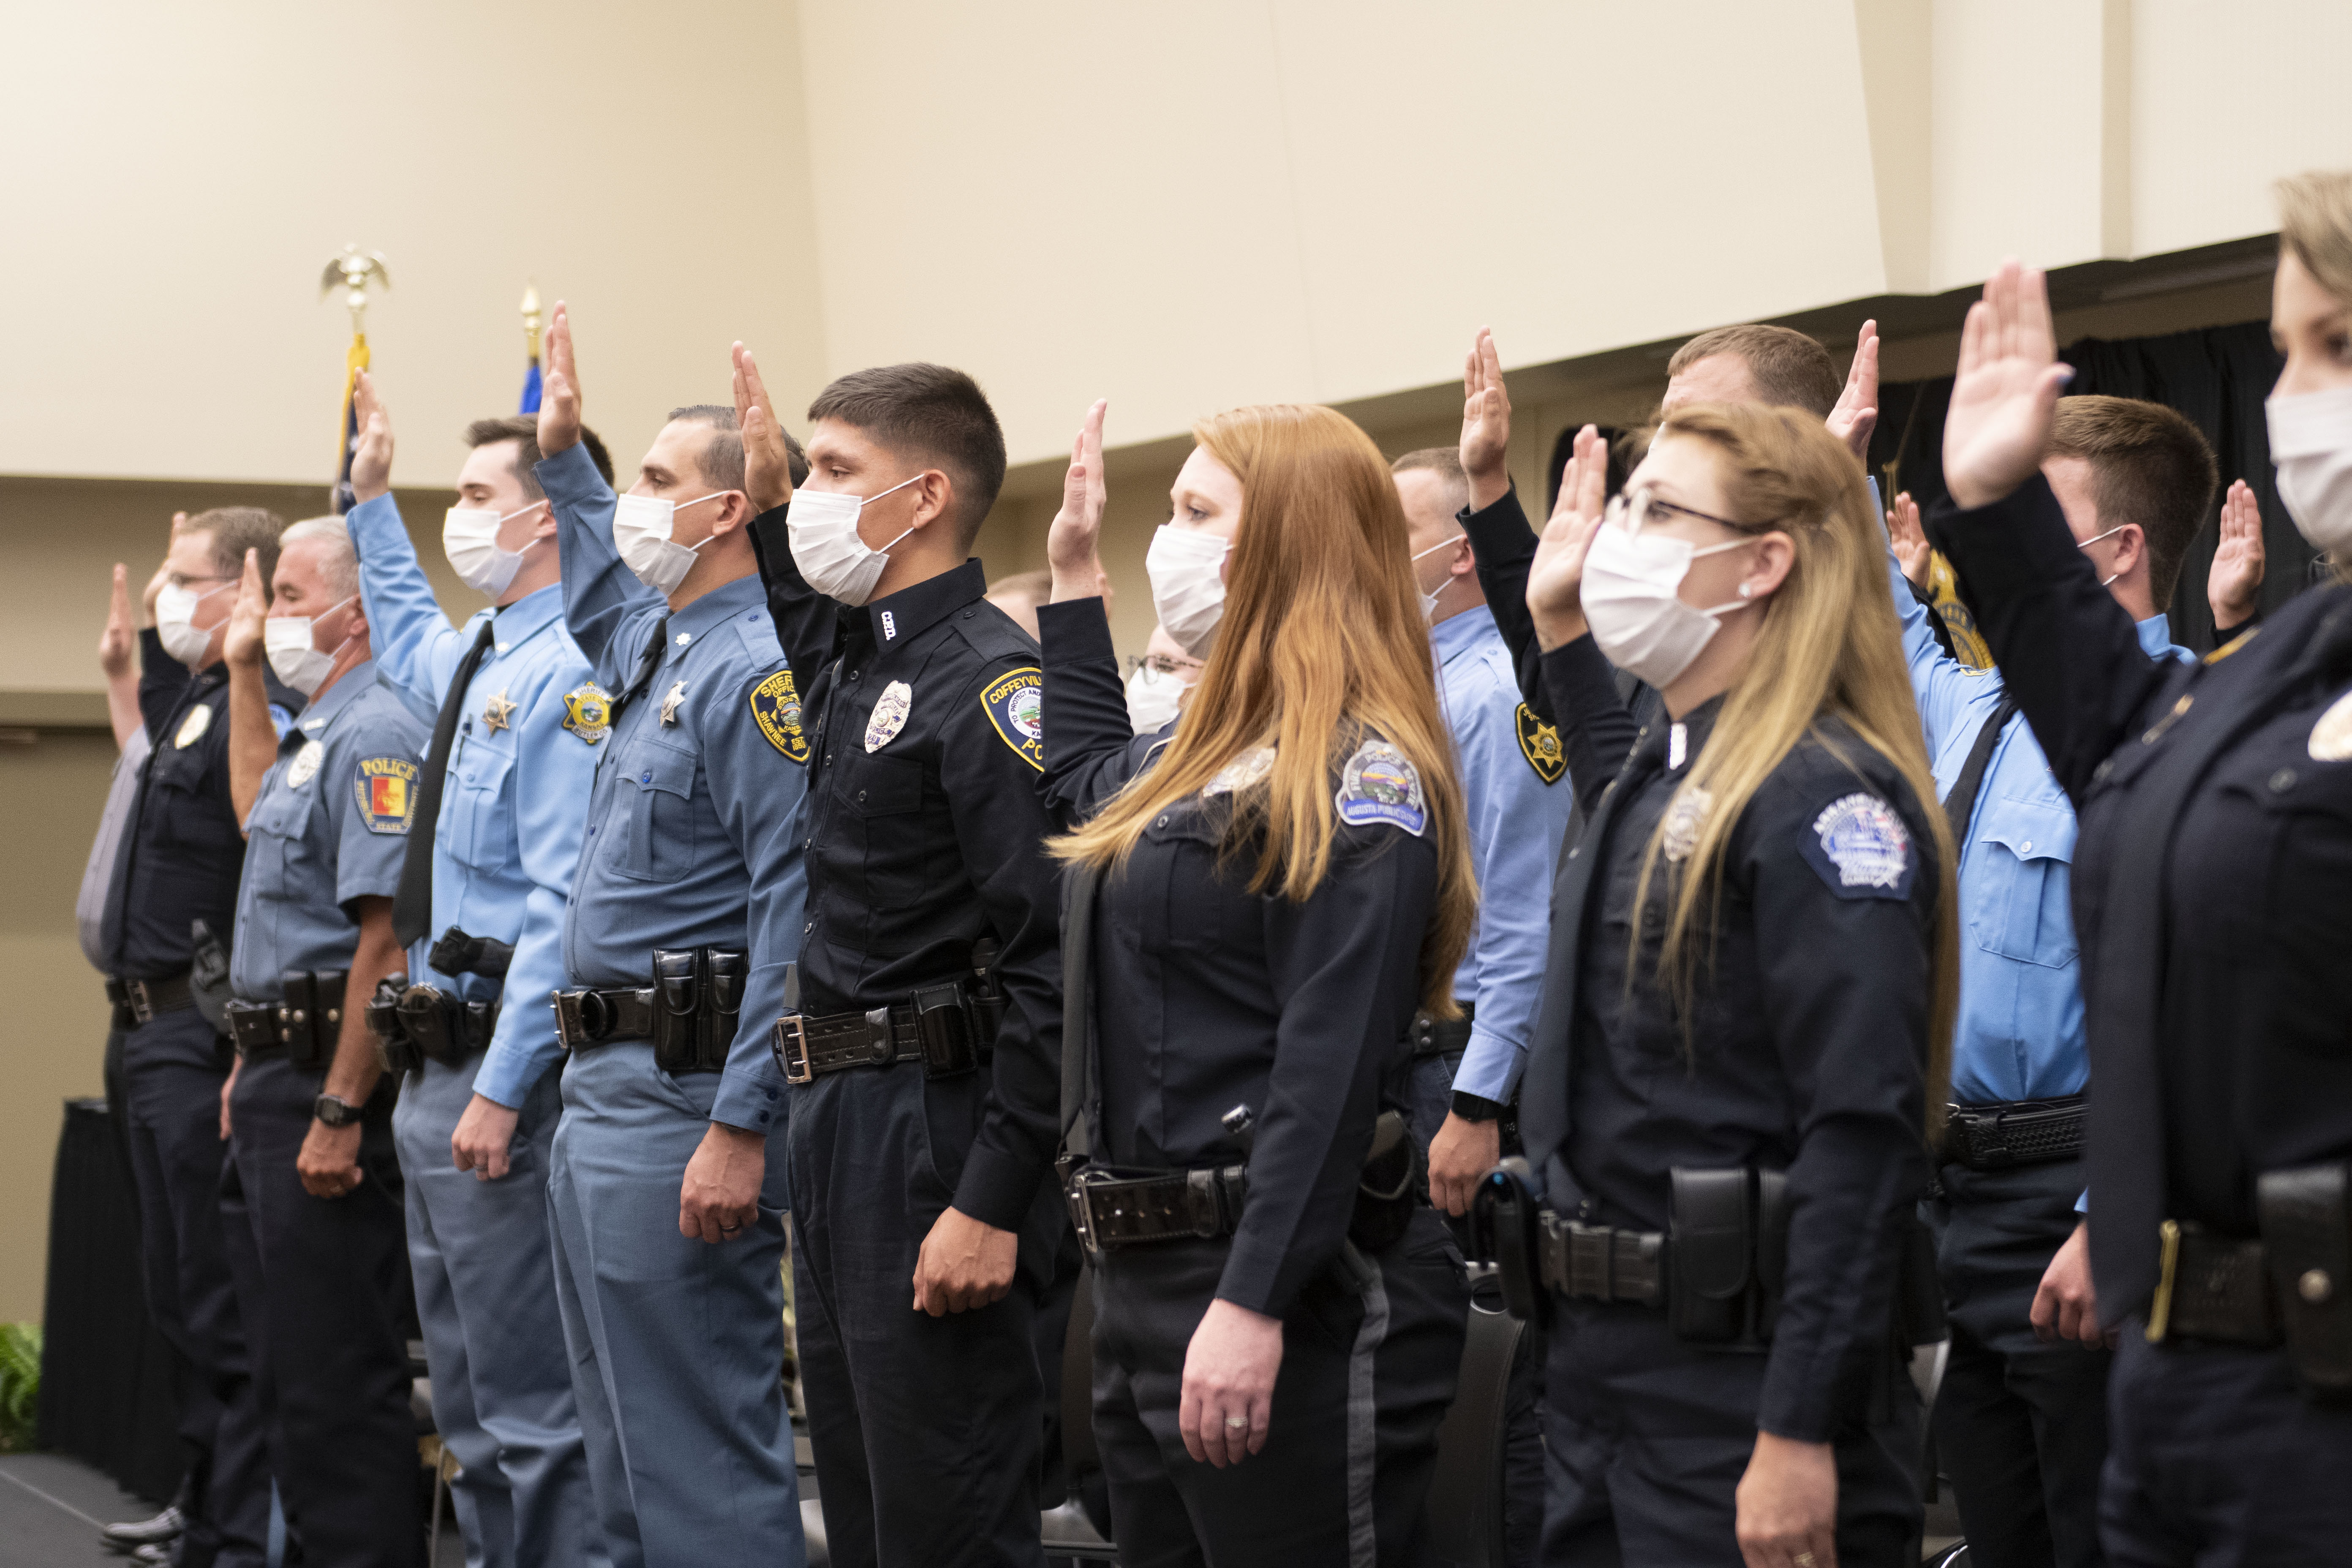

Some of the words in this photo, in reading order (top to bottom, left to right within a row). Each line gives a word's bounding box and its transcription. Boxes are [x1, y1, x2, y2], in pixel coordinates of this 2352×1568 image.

[576, 688, 606, 697] SHERIFF
[773, 685, 795, 698] OFFIC
[778, 697, 793, 710] STATE
[1010, 691, 1026, 711] PROTECT
[1012, 715, 1019, 724] TO
[574, 727, 598, 738] BUTLER
[760, 711, 787, 747] SHAWNEE
[868, 734, 877, 743] 29
[792, 742, 806, 751] 1855
[1365, 754, 1401, 765] POLICE
[361, 758, 416, 780] POLICE
[1346, 803, 1377, 816] AUGUSTA
